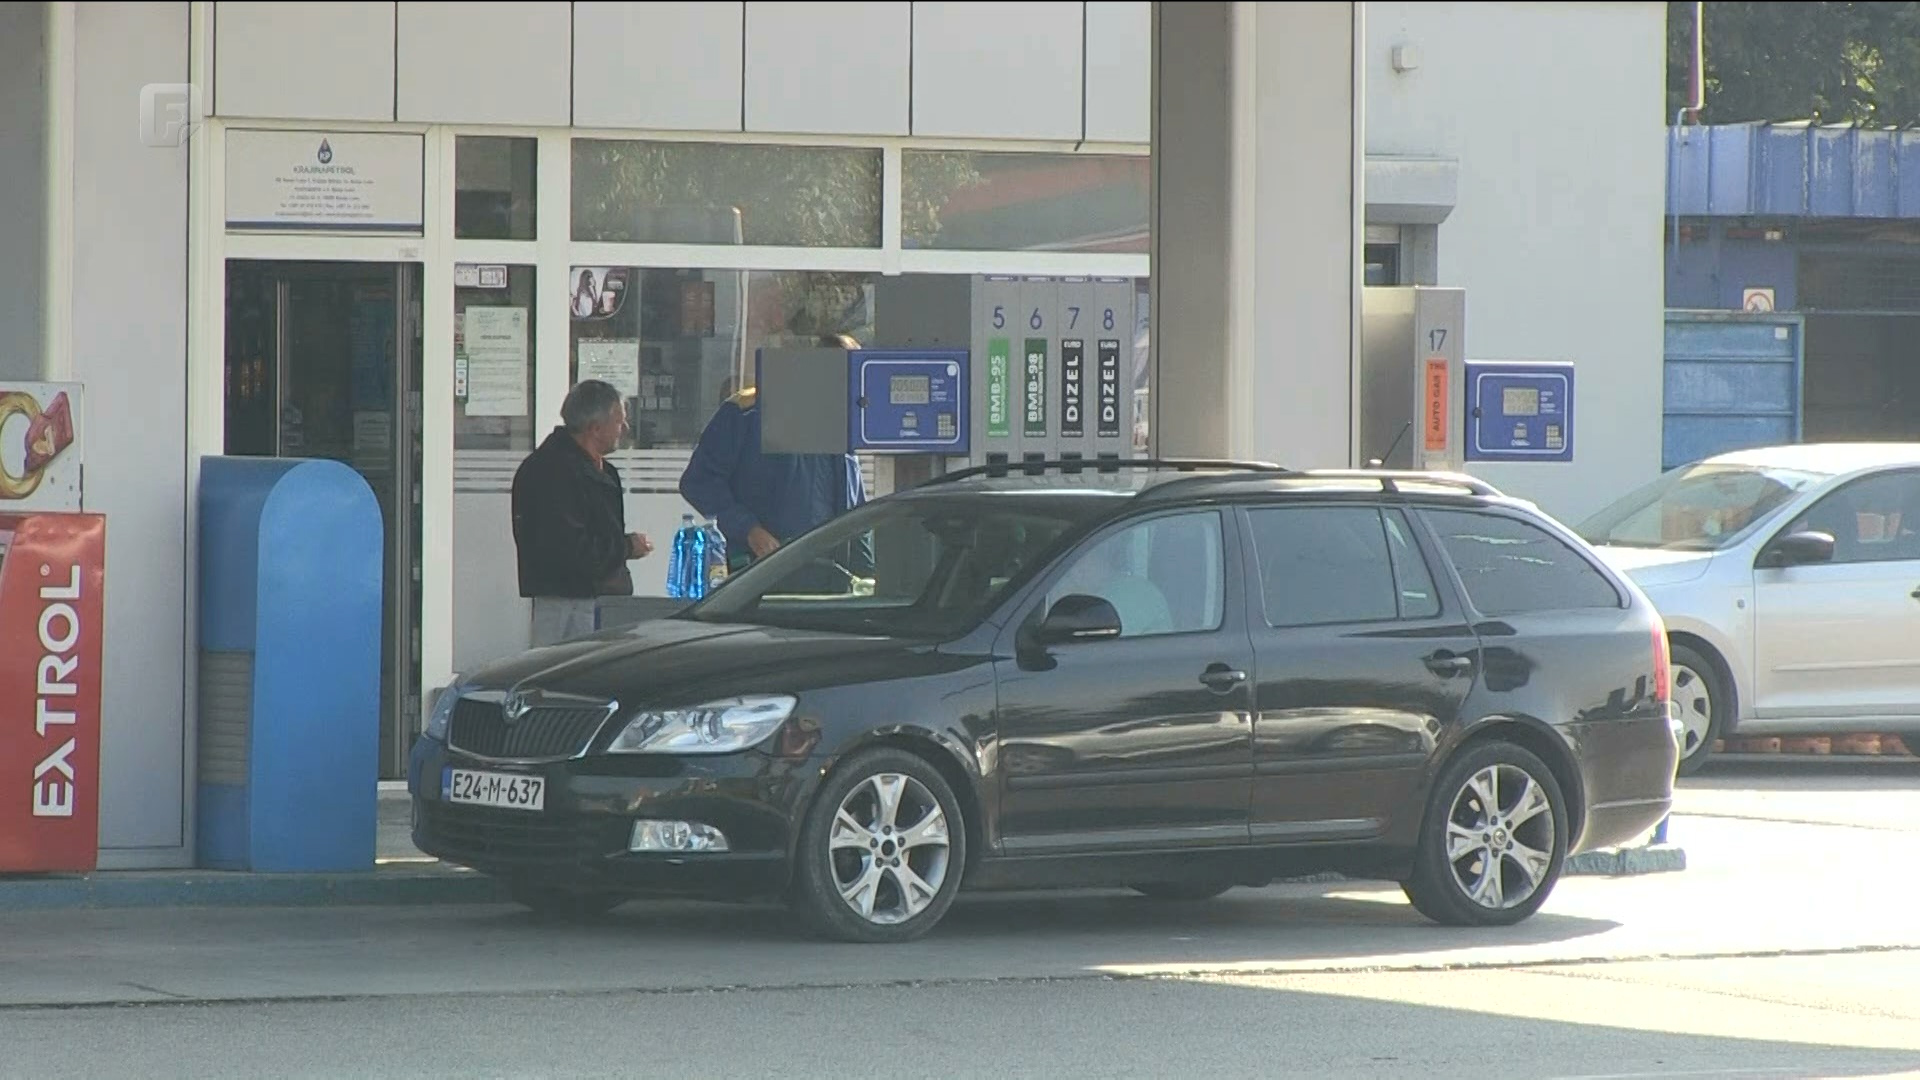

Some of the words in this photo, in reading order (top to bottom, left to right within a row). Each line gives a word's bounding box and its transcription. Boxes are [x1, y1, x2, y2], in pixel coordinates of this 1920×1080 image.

[992, 306, 1005, 330] 5
[1029, 307, 1042, 330] 6
[1067, 306, 1081, 330] 7
[1102, 308, 1114, 331] 8
[1428, 328, 1447, 352] 17
[990, 355, 1001, 424] BMB-95
[1027, 353, 1039, 423] BMB-98
[1066, 355, 1079, 423] DIZEL
[1102, 355, 1115, 423] DIZEL
[32, 564, 81, 817] EXTROL
[452, 772, 542, 806] E24-M-637
